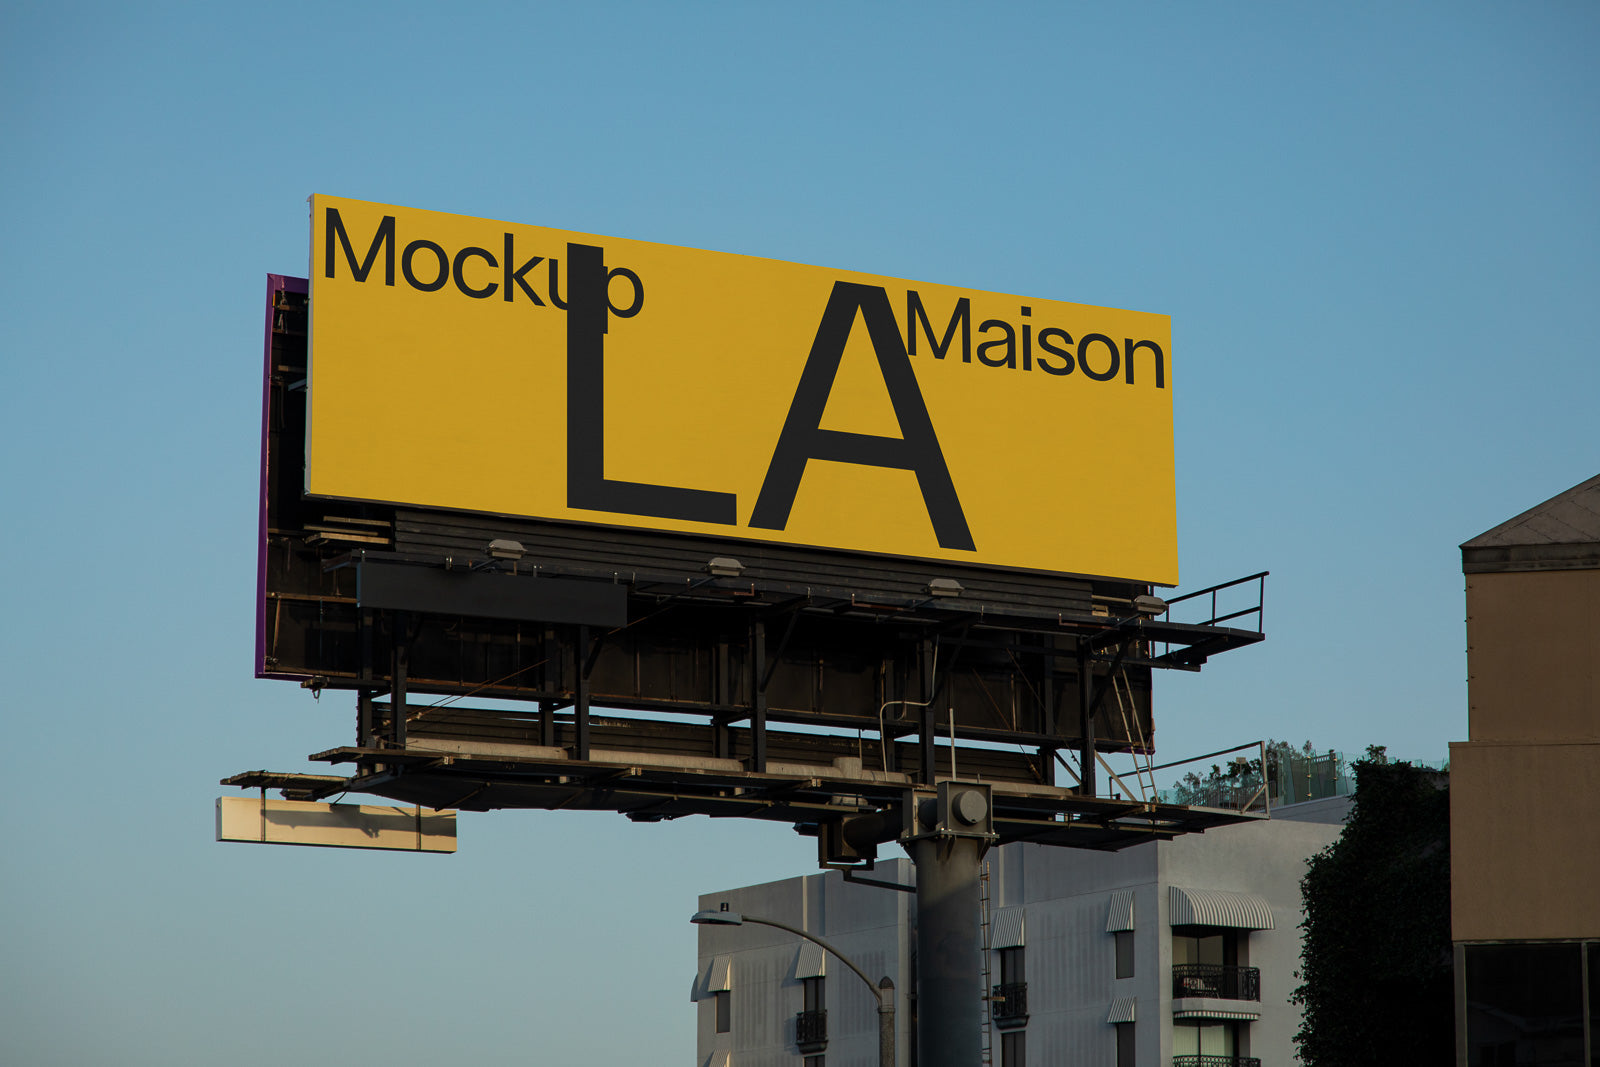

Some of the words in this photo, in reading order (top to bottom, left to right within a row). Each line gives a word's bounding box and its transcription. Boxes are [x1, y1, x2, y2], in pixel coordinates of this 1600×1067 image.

[325, 207, 645, 334] Mockup
[567, 243, 977, 552] LA
[907, 290, 1165, 389] Maison
